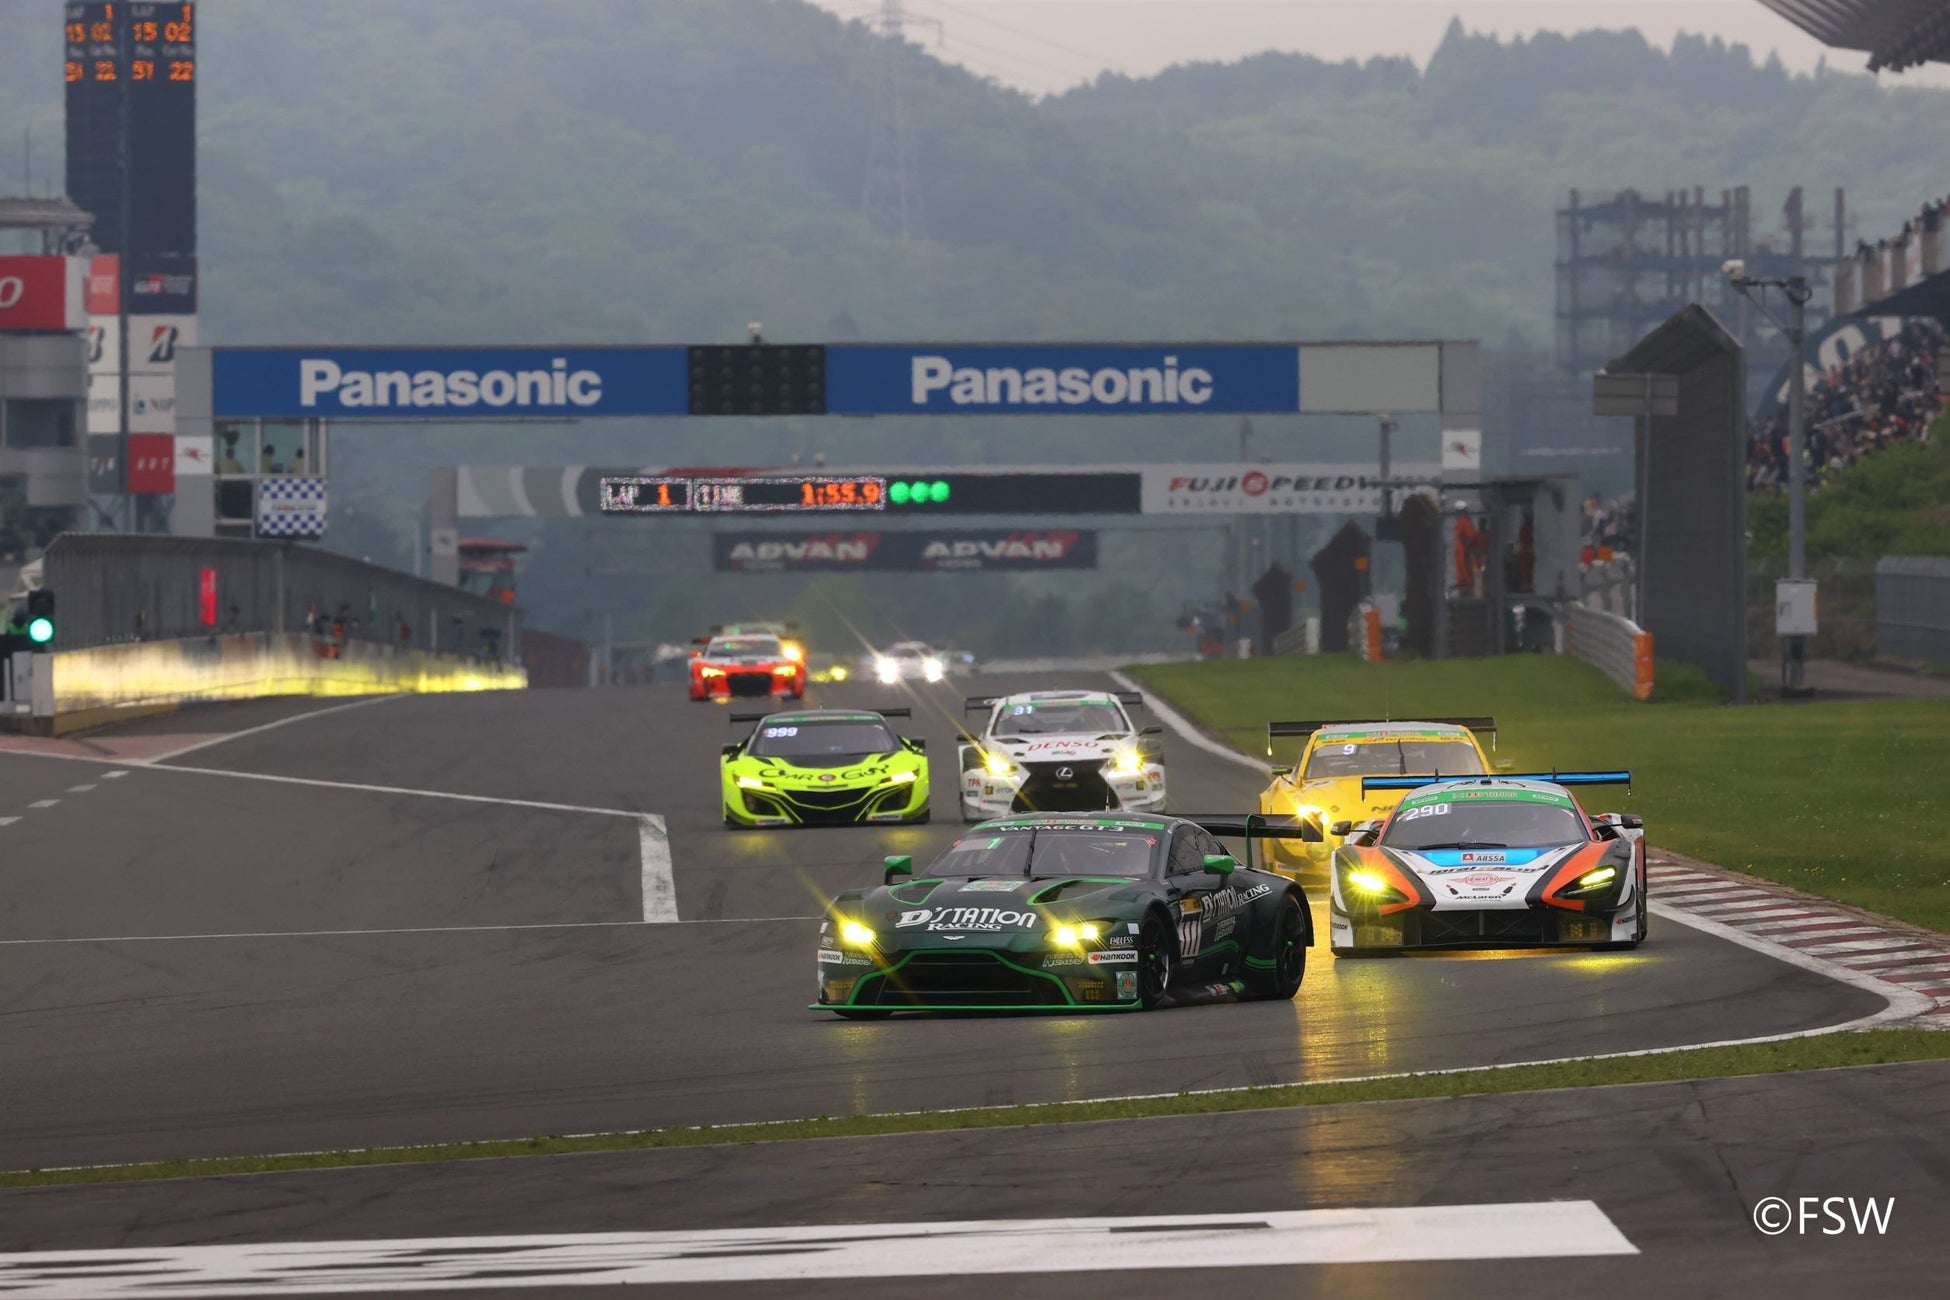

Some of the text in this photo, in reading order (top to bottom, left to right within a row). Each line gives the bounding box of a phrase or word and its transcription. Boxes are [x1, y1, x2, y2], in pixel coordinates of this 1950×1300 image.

[301, 358, 602, 406] Panasonic
[912, 355, 1213, 404] Panasonic
[1168, 475, 1239, 492] FUJI
[657, 483, 672, 506] 1
[729, 541, 868, 560] ADVAN
[922, 540, 1064, 559] ADVAN
[766, 727, 799, 738] 999
[1027, 741, 1099, 752] DENSO
[1343, 744, 1356, 755] 9
[1406, 803, 1449, 821] 290
[1079, 824, 1124, 832] GT3
[895, 906, 1037, 928] D'STATION
[926, 922, 1003, 931] RACING
[1109, 936, 1134, 945] ENDLESS
